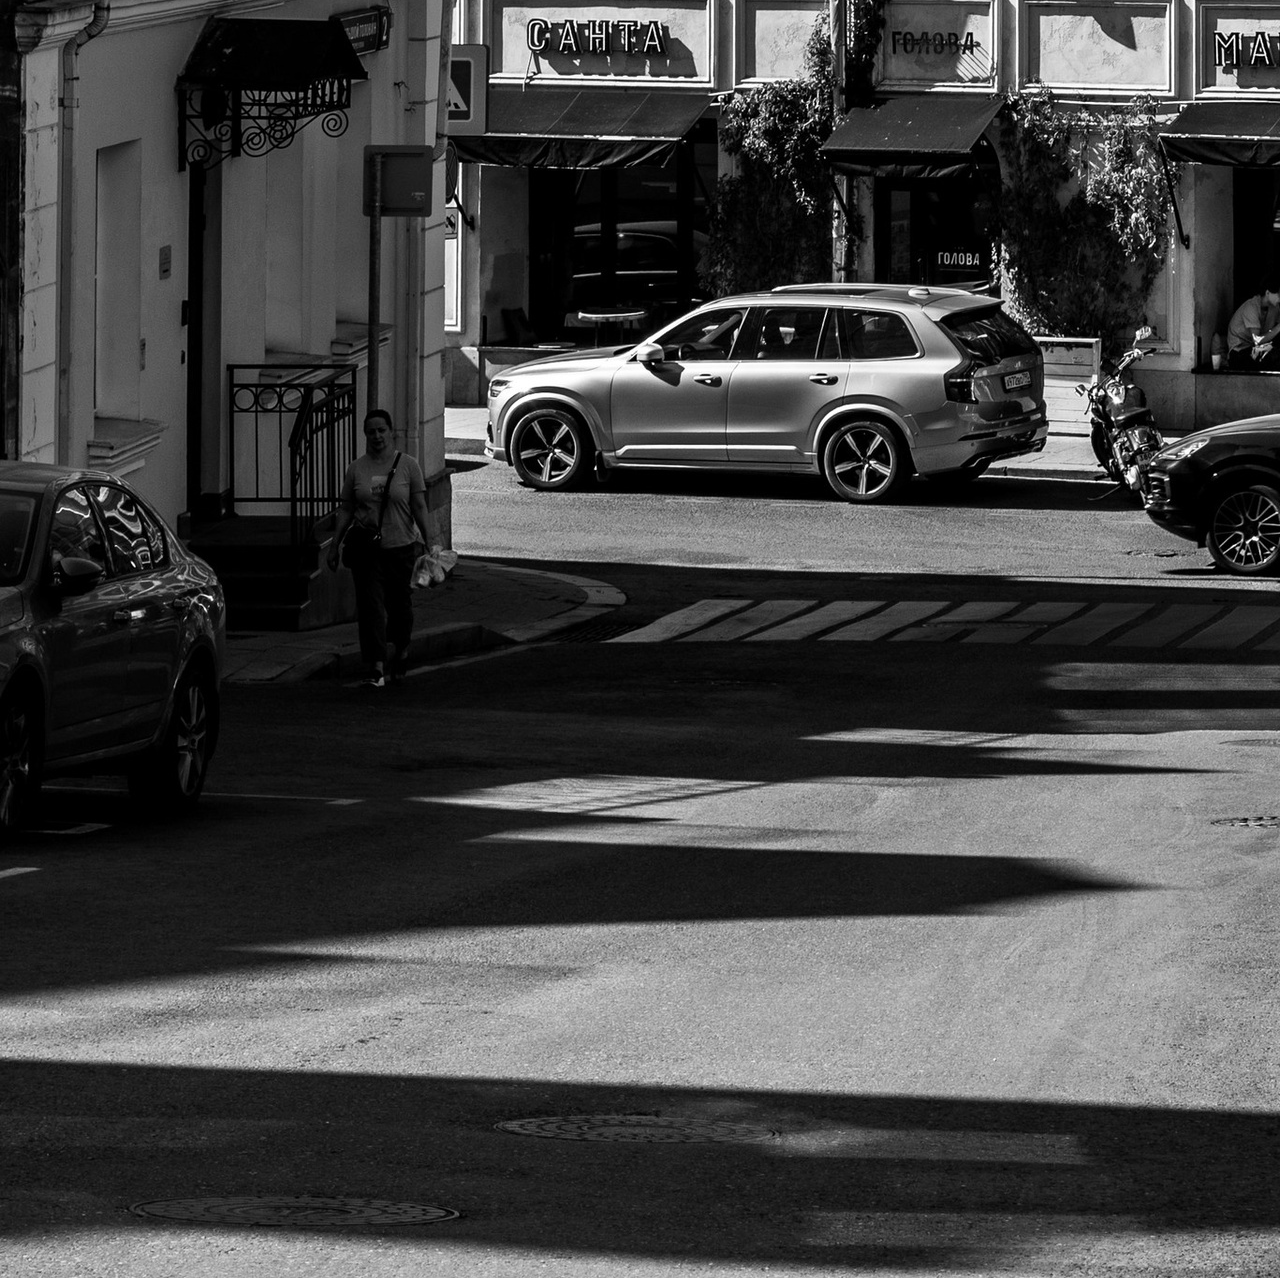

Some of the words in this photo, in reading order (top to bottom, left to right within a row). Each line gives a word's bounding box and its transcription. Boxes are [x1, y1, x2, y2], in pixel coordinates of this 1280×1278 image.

[382, 16, 388, 41] 2
[526, 18, 668, 55] САНТА
[891, 31, 975, 55] ГОЛОВА
[937, 251, 980, 266] ГОЛОВА
